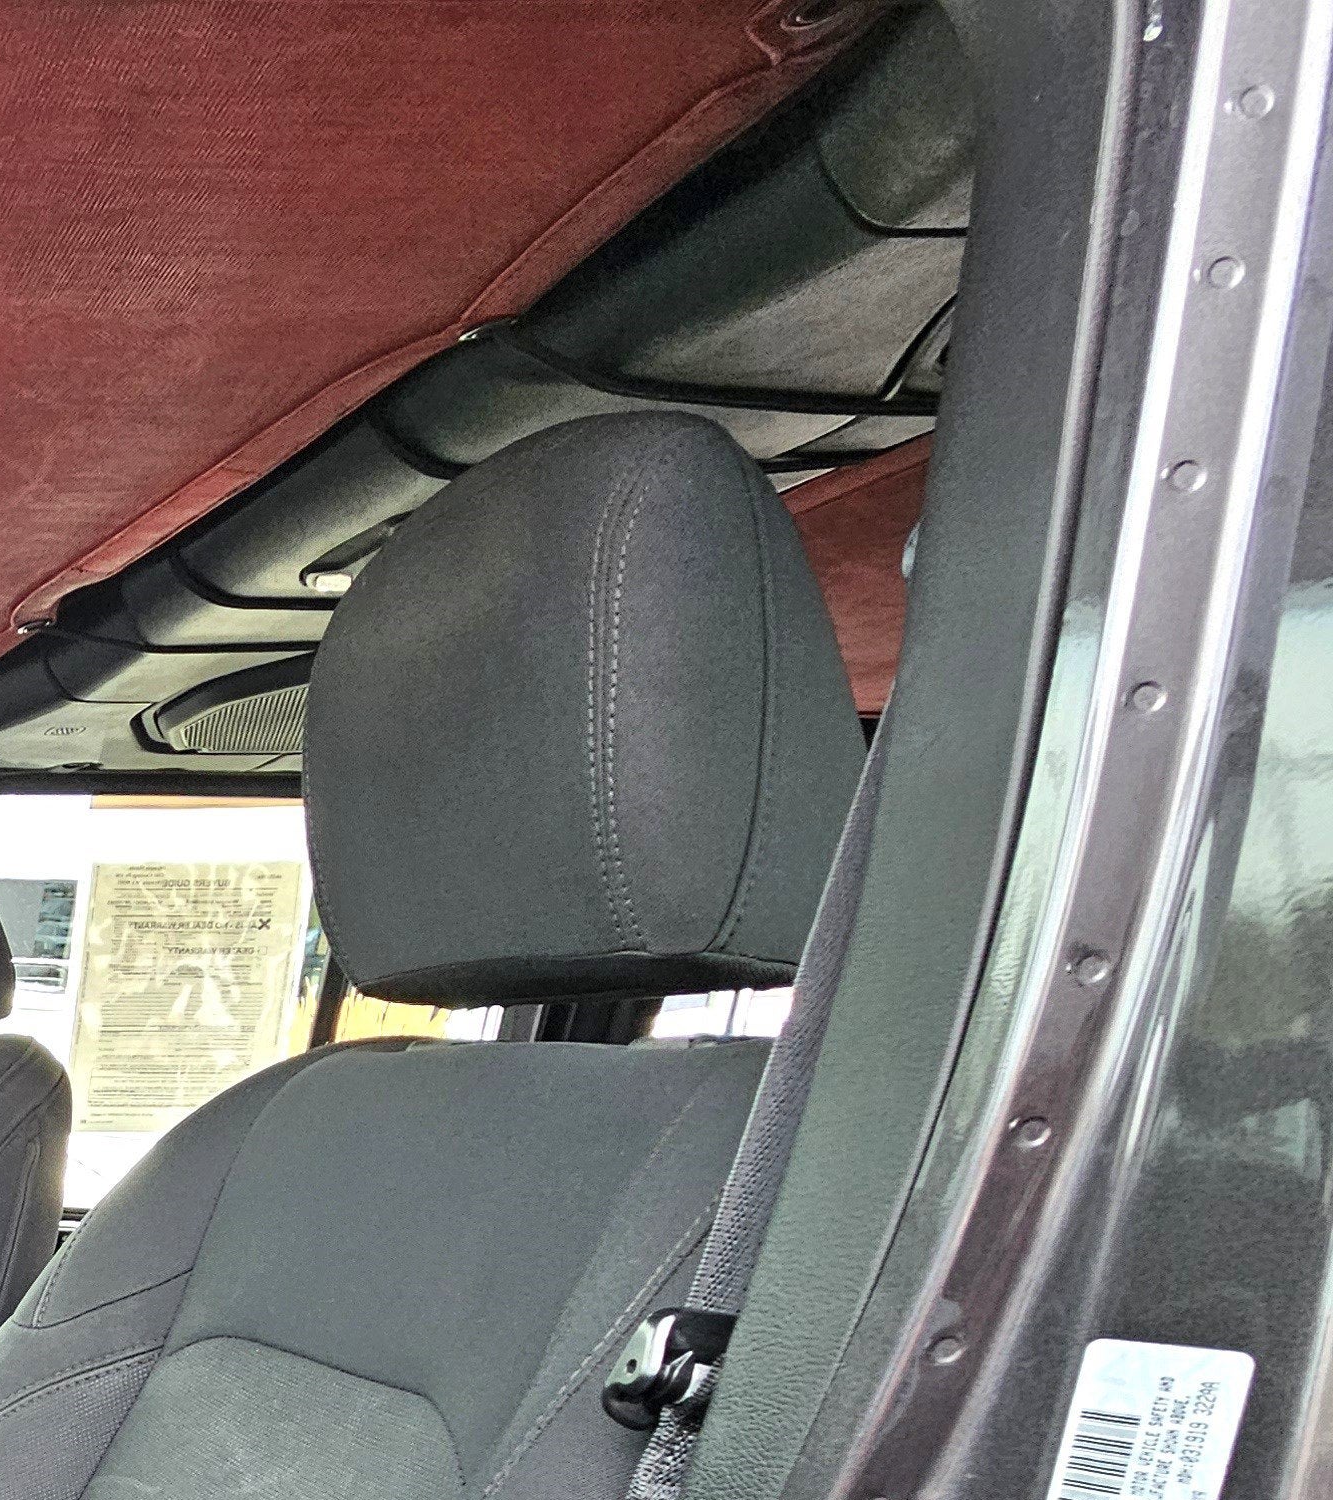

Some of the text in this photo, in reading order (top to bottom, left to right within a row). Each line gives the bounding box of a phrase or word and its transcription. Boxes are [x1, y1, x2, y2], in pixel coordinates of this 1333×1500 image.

[1159, 1376, 1175, 1392] AND
[1147, 1396, 1168, 1426] SAFETY
[1138, 1431, 1161, 1466] VEHICLE
[1129, 1470, 1149, 1495] MOTOR
